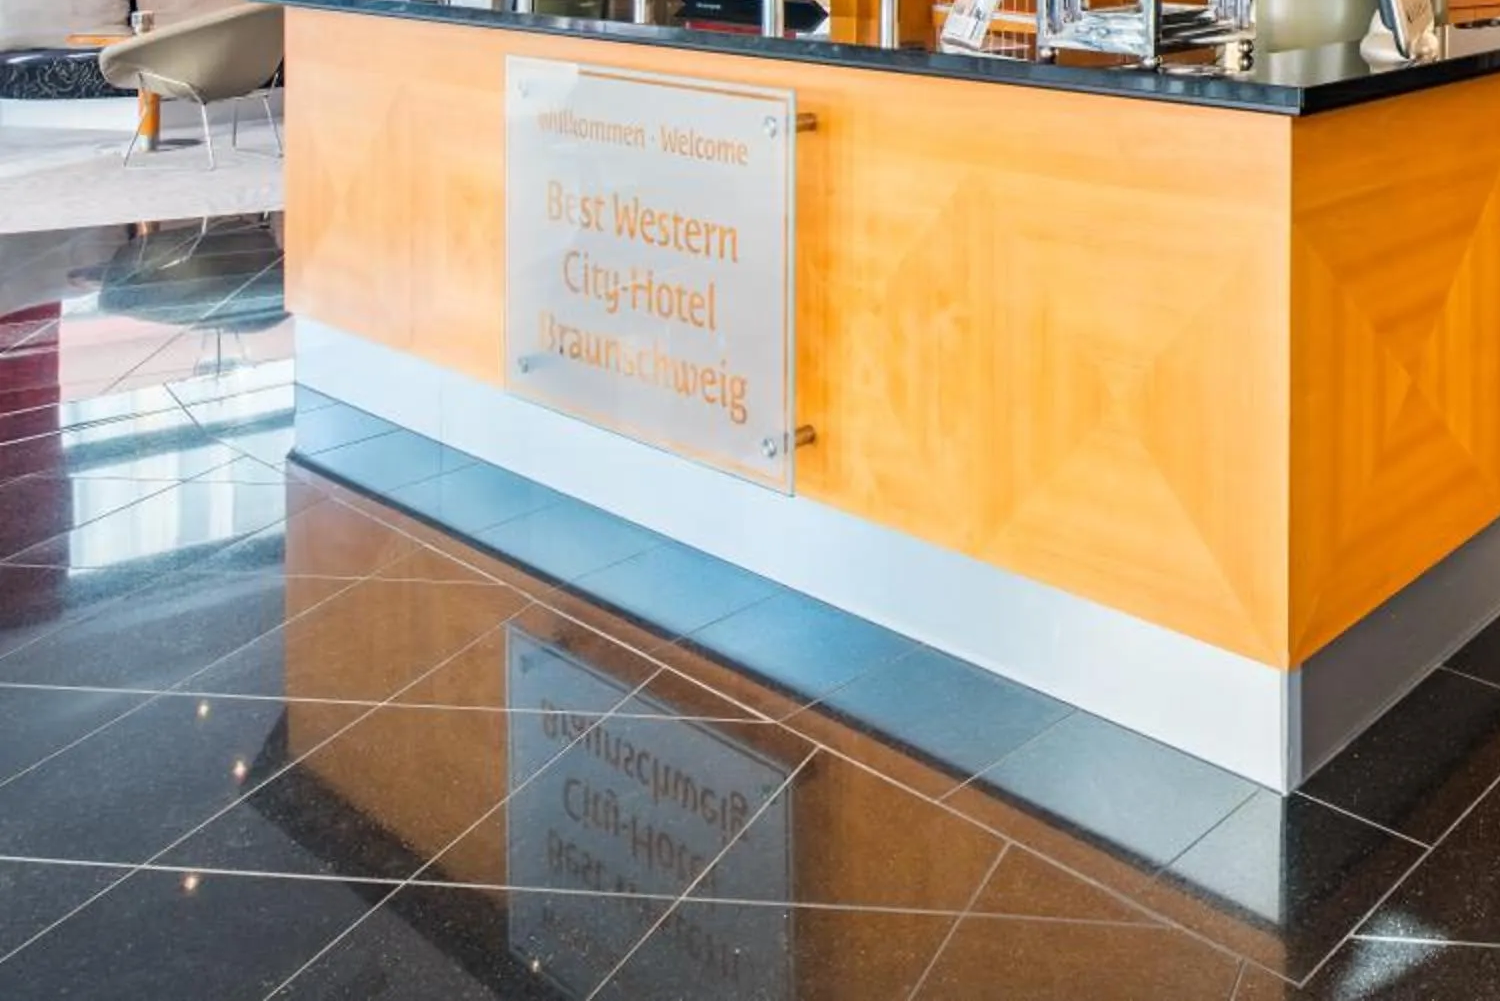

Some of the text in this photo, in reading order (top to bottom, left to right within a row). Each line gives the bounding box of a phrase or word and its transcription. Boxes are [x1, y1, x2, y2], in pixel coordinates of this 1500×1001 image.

[659, 124, 748, 165] Welcome
[548, 180, 738, 264] Best Western
[563, 250, 716, 331] City-Hotel
[540, 310, 748, 424] Braunschweig
